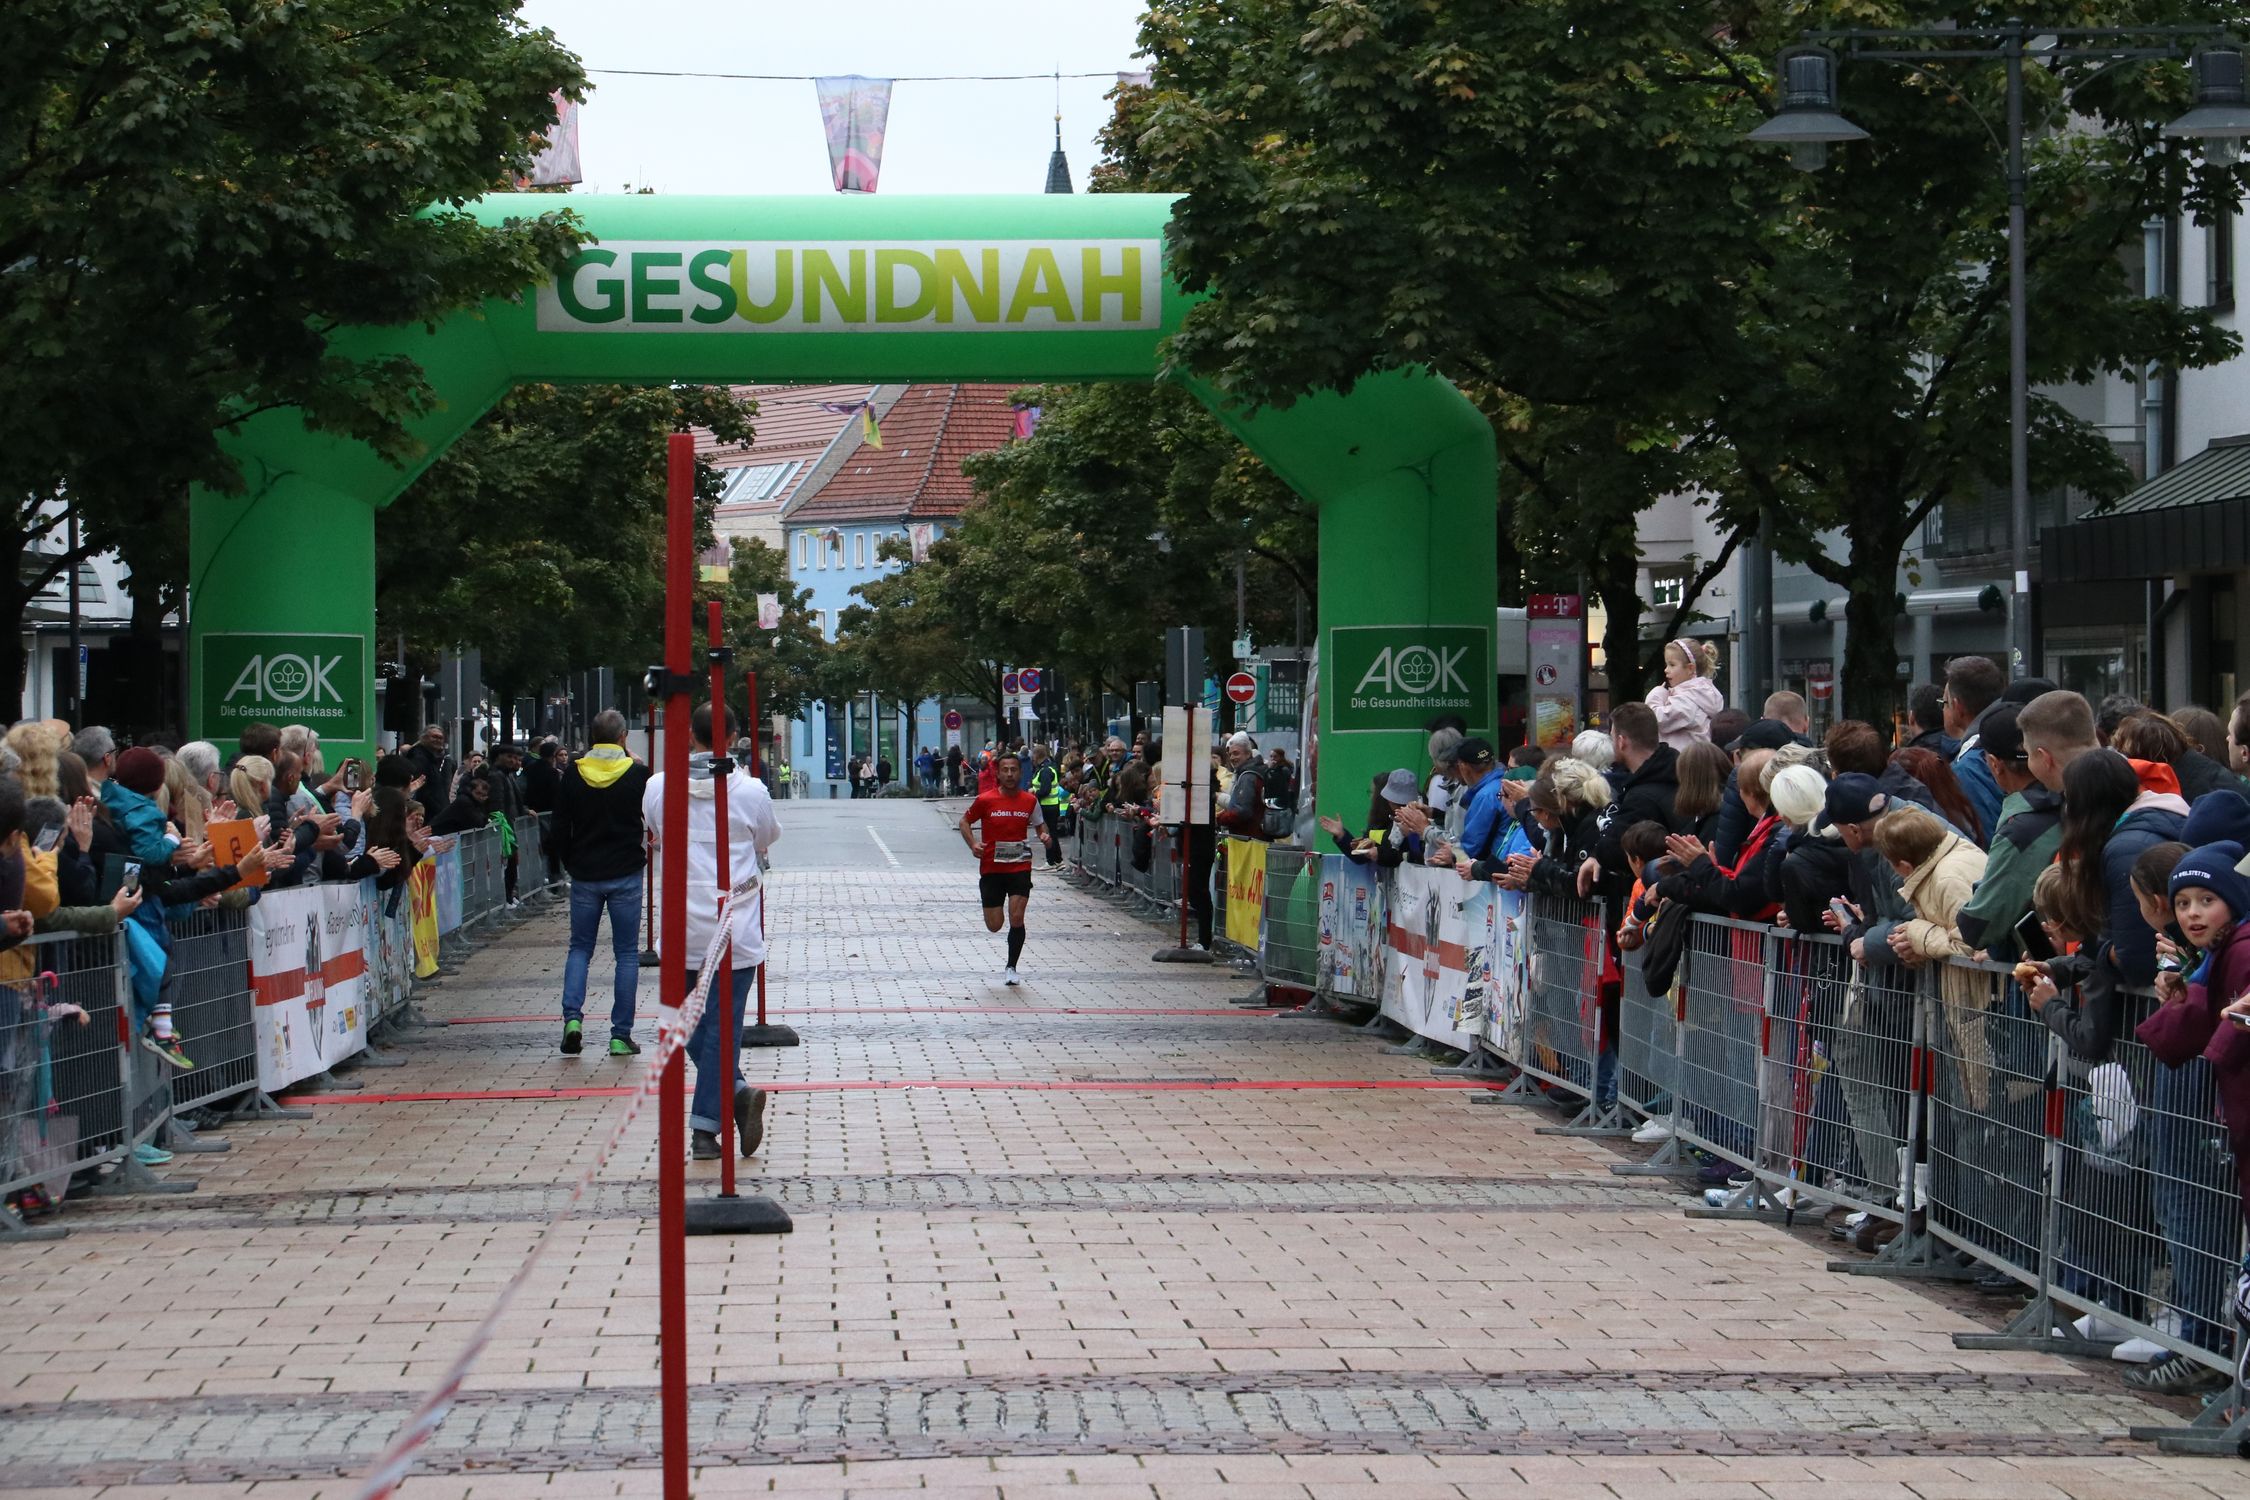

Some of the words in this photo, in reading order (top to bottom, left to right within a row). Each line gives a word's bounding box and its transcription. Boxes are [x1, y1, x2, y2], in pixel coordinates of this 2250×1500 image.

[1353, 645, 1470, 694] AOK
[223, 653, 344, 703] AOK
[1351, 697, 1367, 709] Die
[220, 705, 236, 717] Die
[239, 705, 346, 718] Gesundheitskasse.
[990, 809, 1012, 817] MÖBEL
